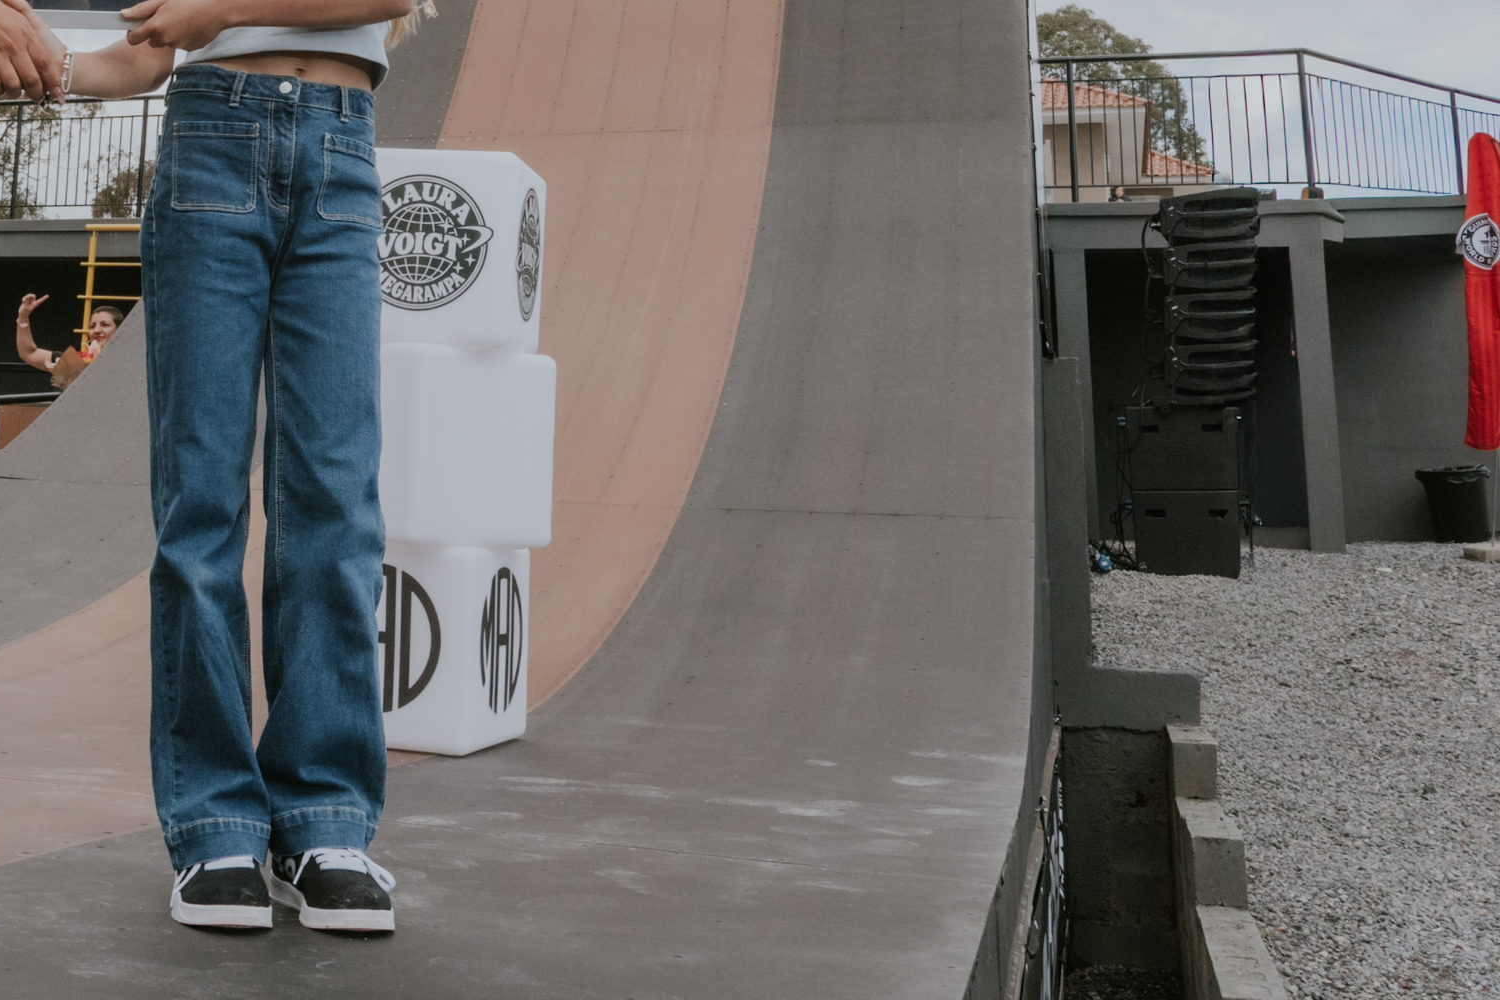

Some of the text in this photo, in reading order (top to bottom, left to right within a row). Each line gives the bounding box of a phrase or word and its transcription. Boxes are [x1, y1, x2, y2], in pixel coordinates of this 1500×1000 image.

[382, 183, 470, 225] LAURA
[376, 231, 464, 261] VOIGT
[1464, 237, 1485, 262] WORLD
[480, 566, 522, 714] MAD
